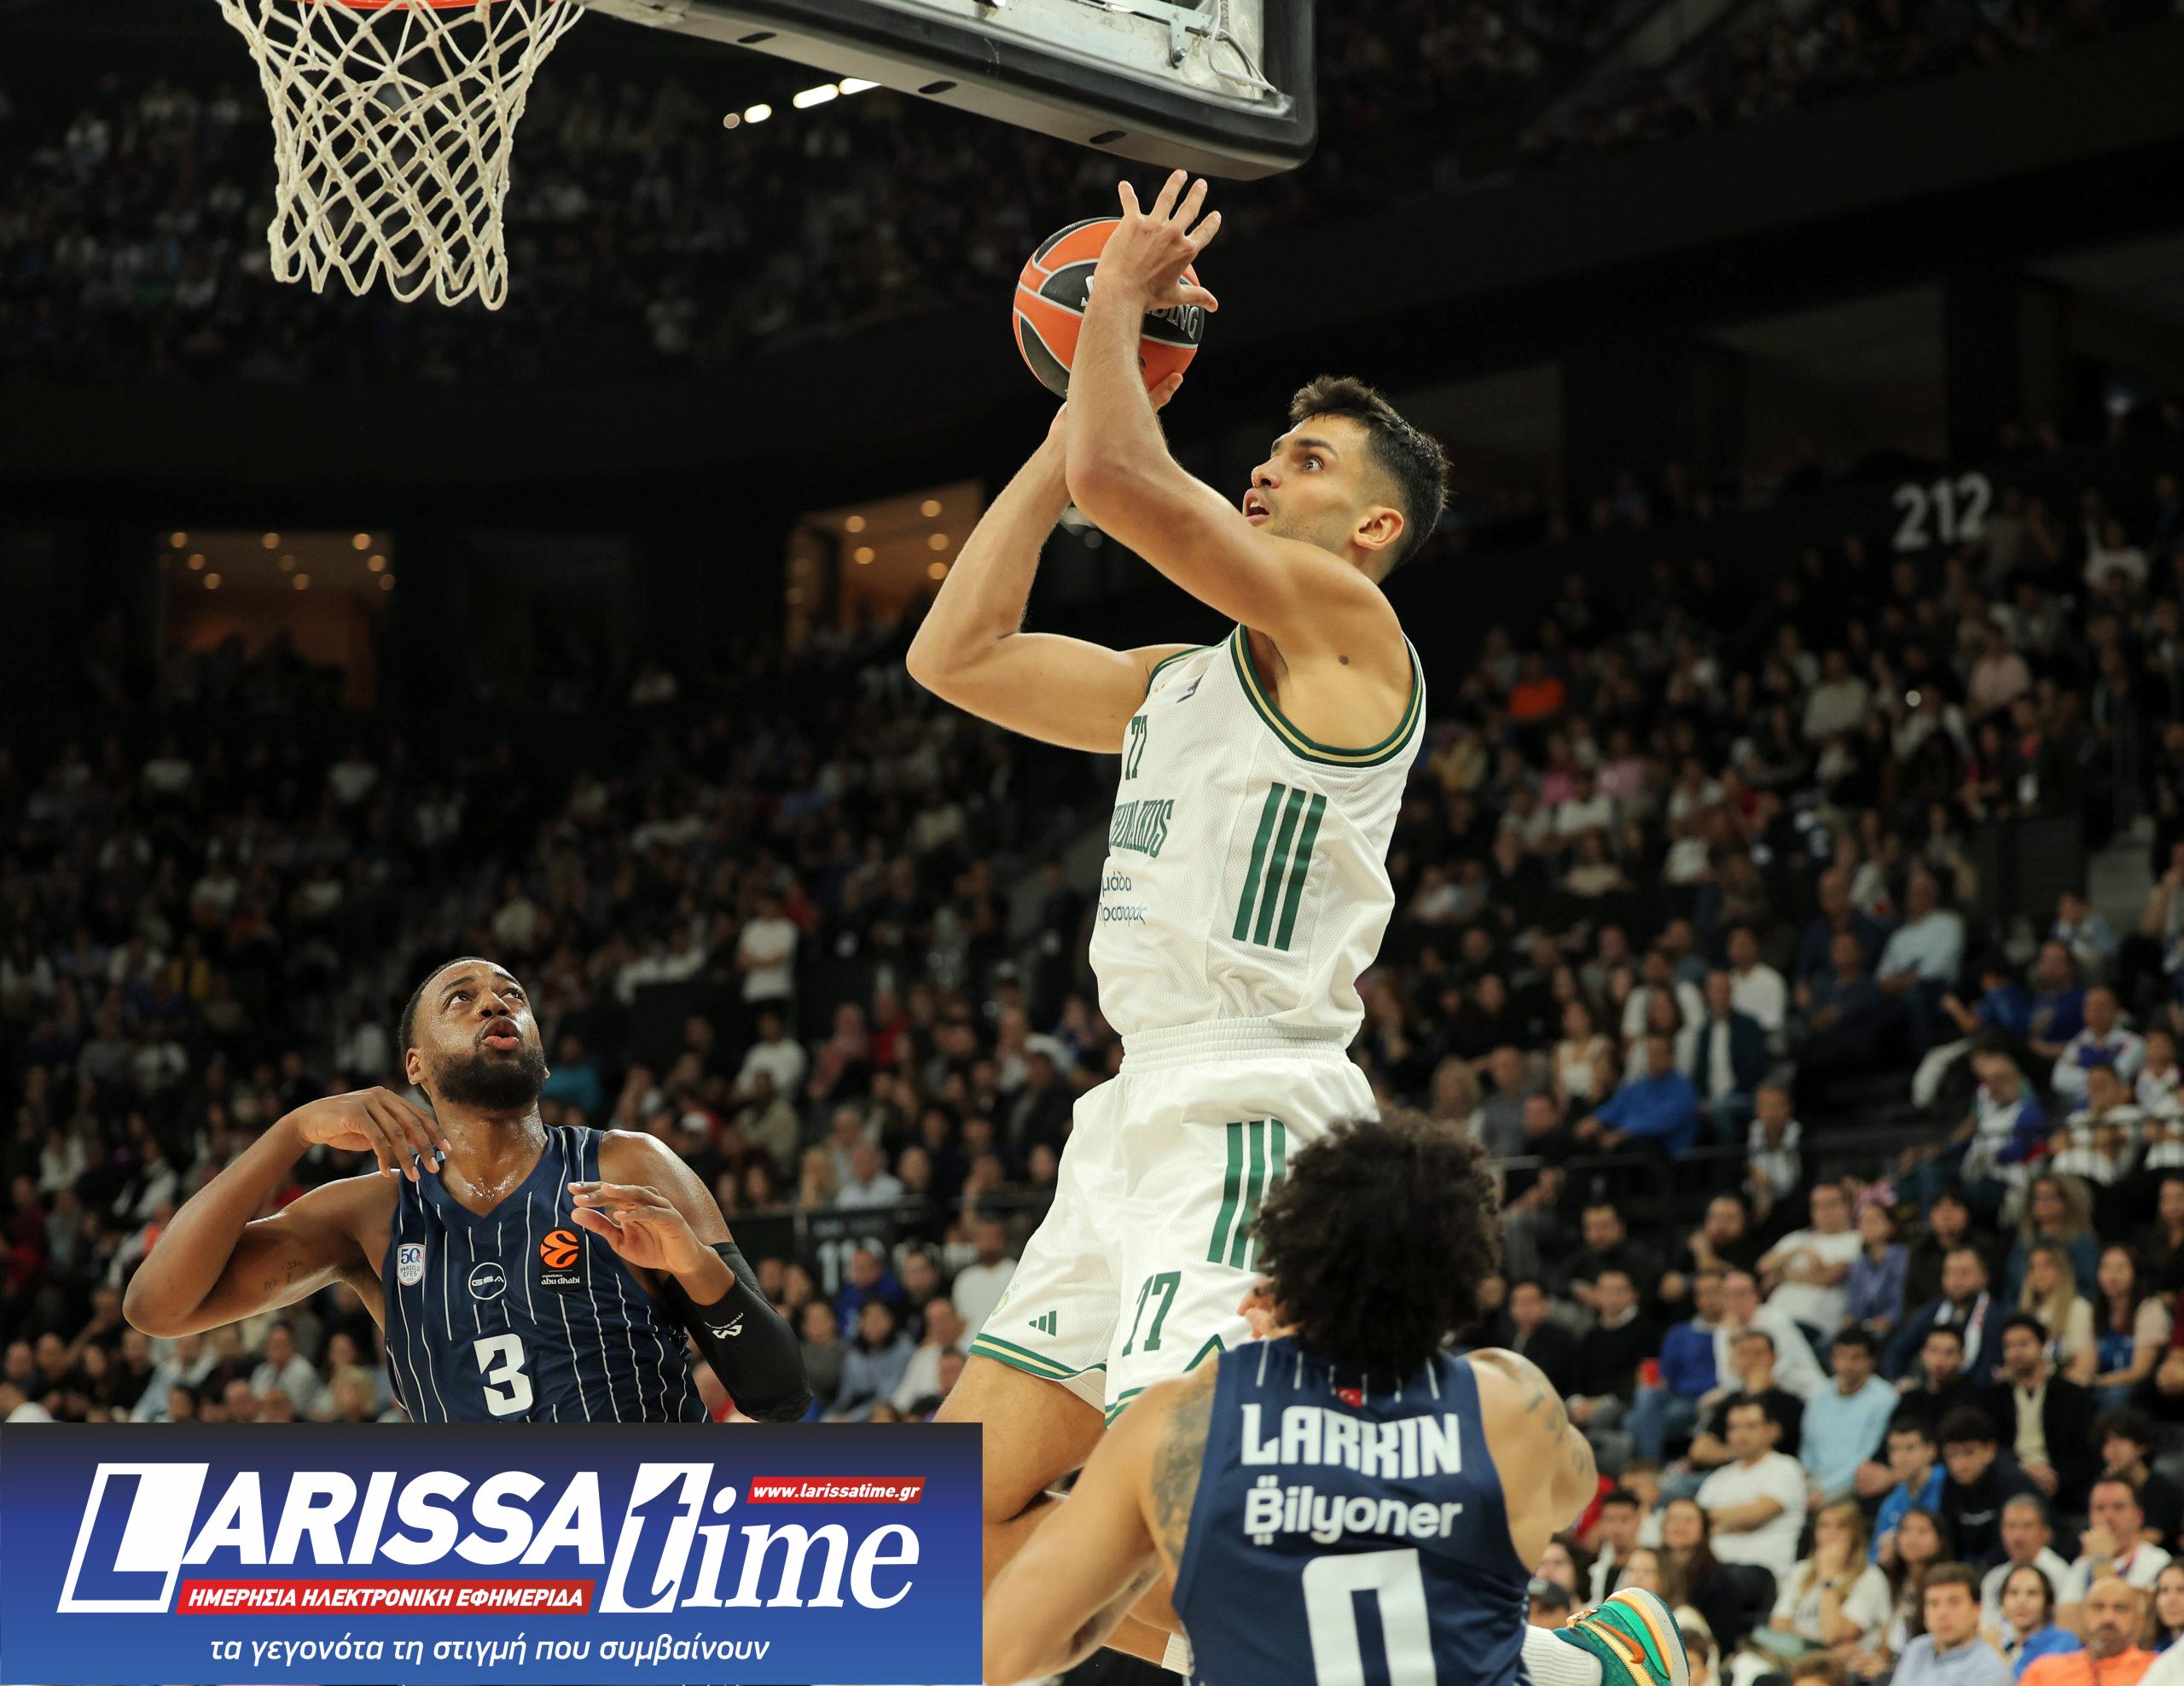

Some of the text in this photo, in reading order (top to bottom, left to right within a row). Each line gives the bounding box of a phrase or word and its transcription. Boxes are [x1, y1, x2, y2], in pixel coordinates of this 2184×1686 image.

[1891, 471, 1993, 551] 212
[1101, 870, 1132, 898] μάδα
[401, 1247, 421, 1264] 50
[473, 1333, 533, 1416] 3
[1240, 1403, 1461, 1480] LARKIN
[1243, 1474, 1463, 1545] Bilyoner
